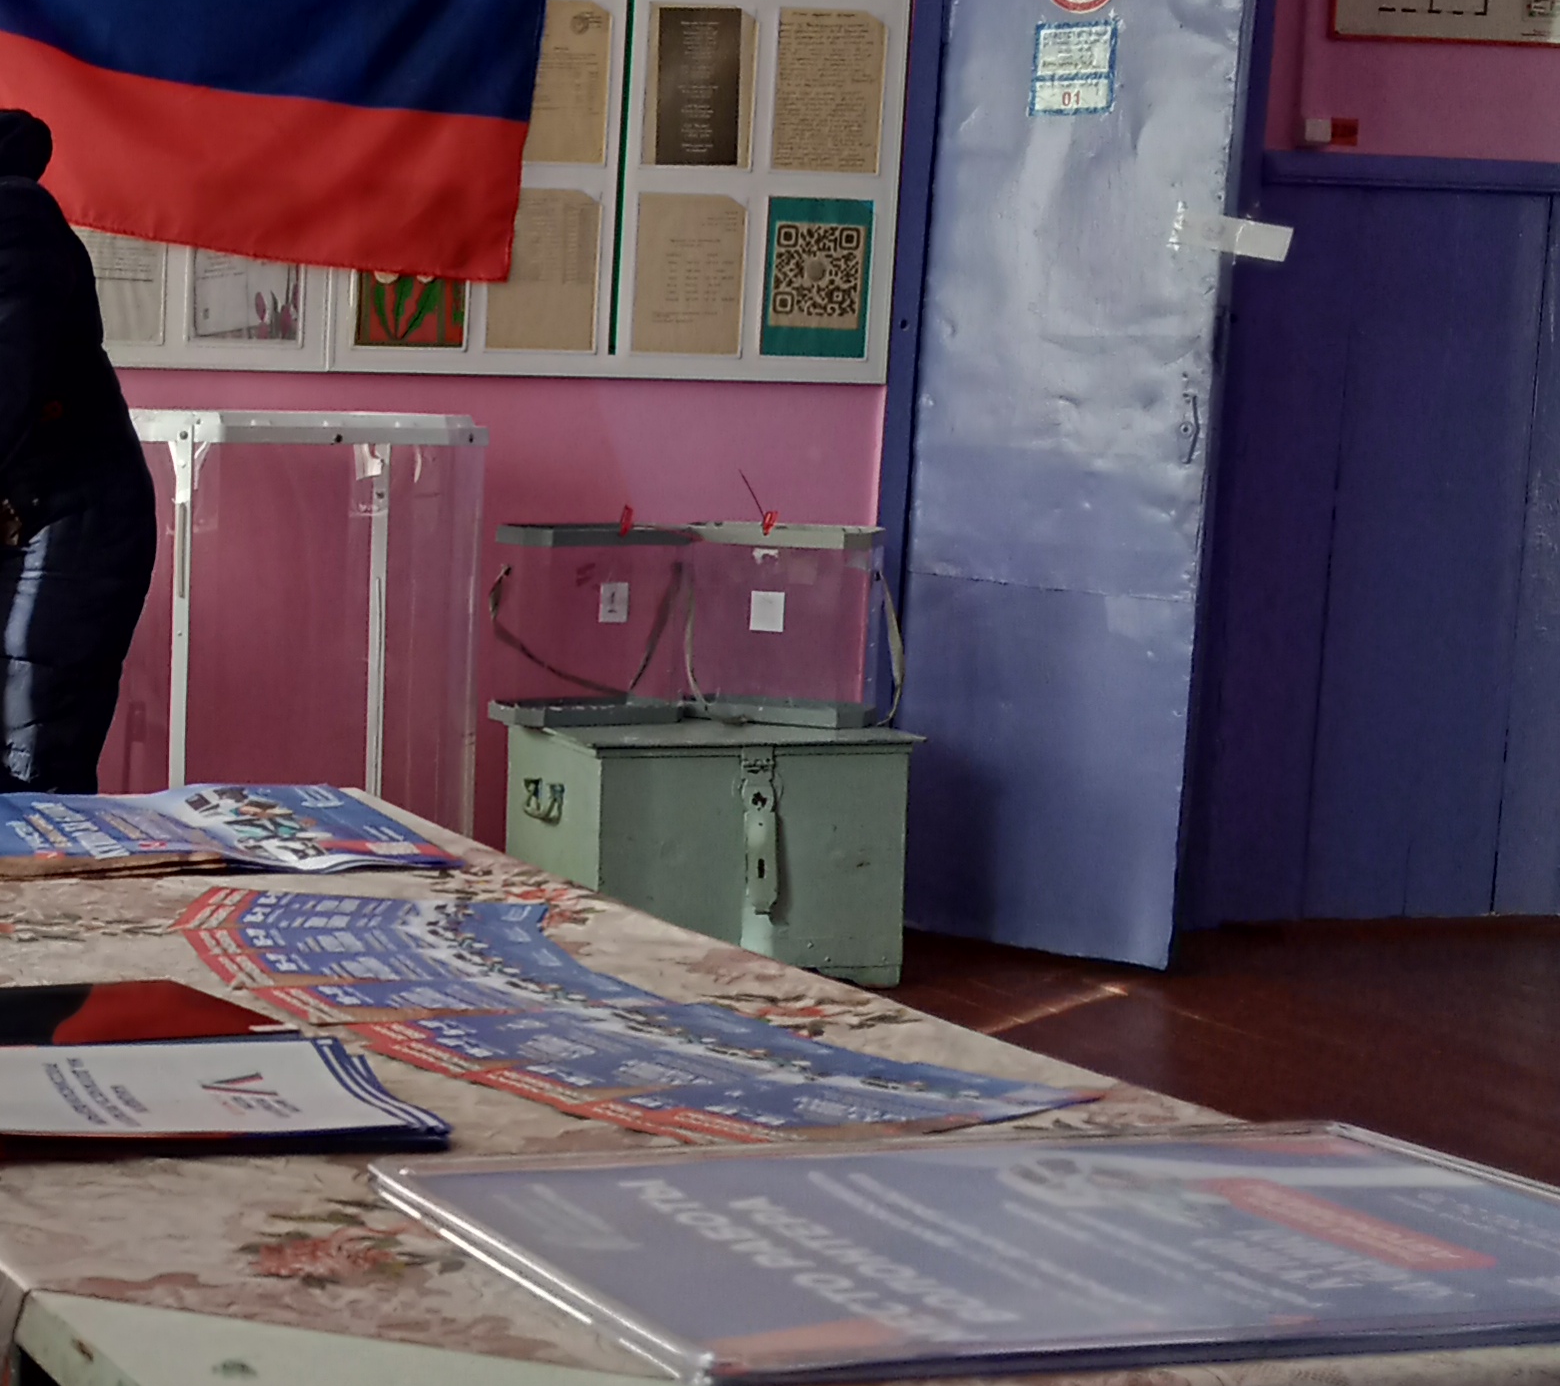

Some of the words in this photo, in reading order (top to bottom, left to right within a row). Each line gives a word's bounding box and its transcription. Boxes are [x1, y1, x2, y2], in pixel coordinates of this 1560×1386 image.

[1062, 90, 1081, 107] 01
[617, 1178, 818, 1268] РАБОТЫ
[727, 1195, 1022, 1323] ВОЛОНТЕРА
